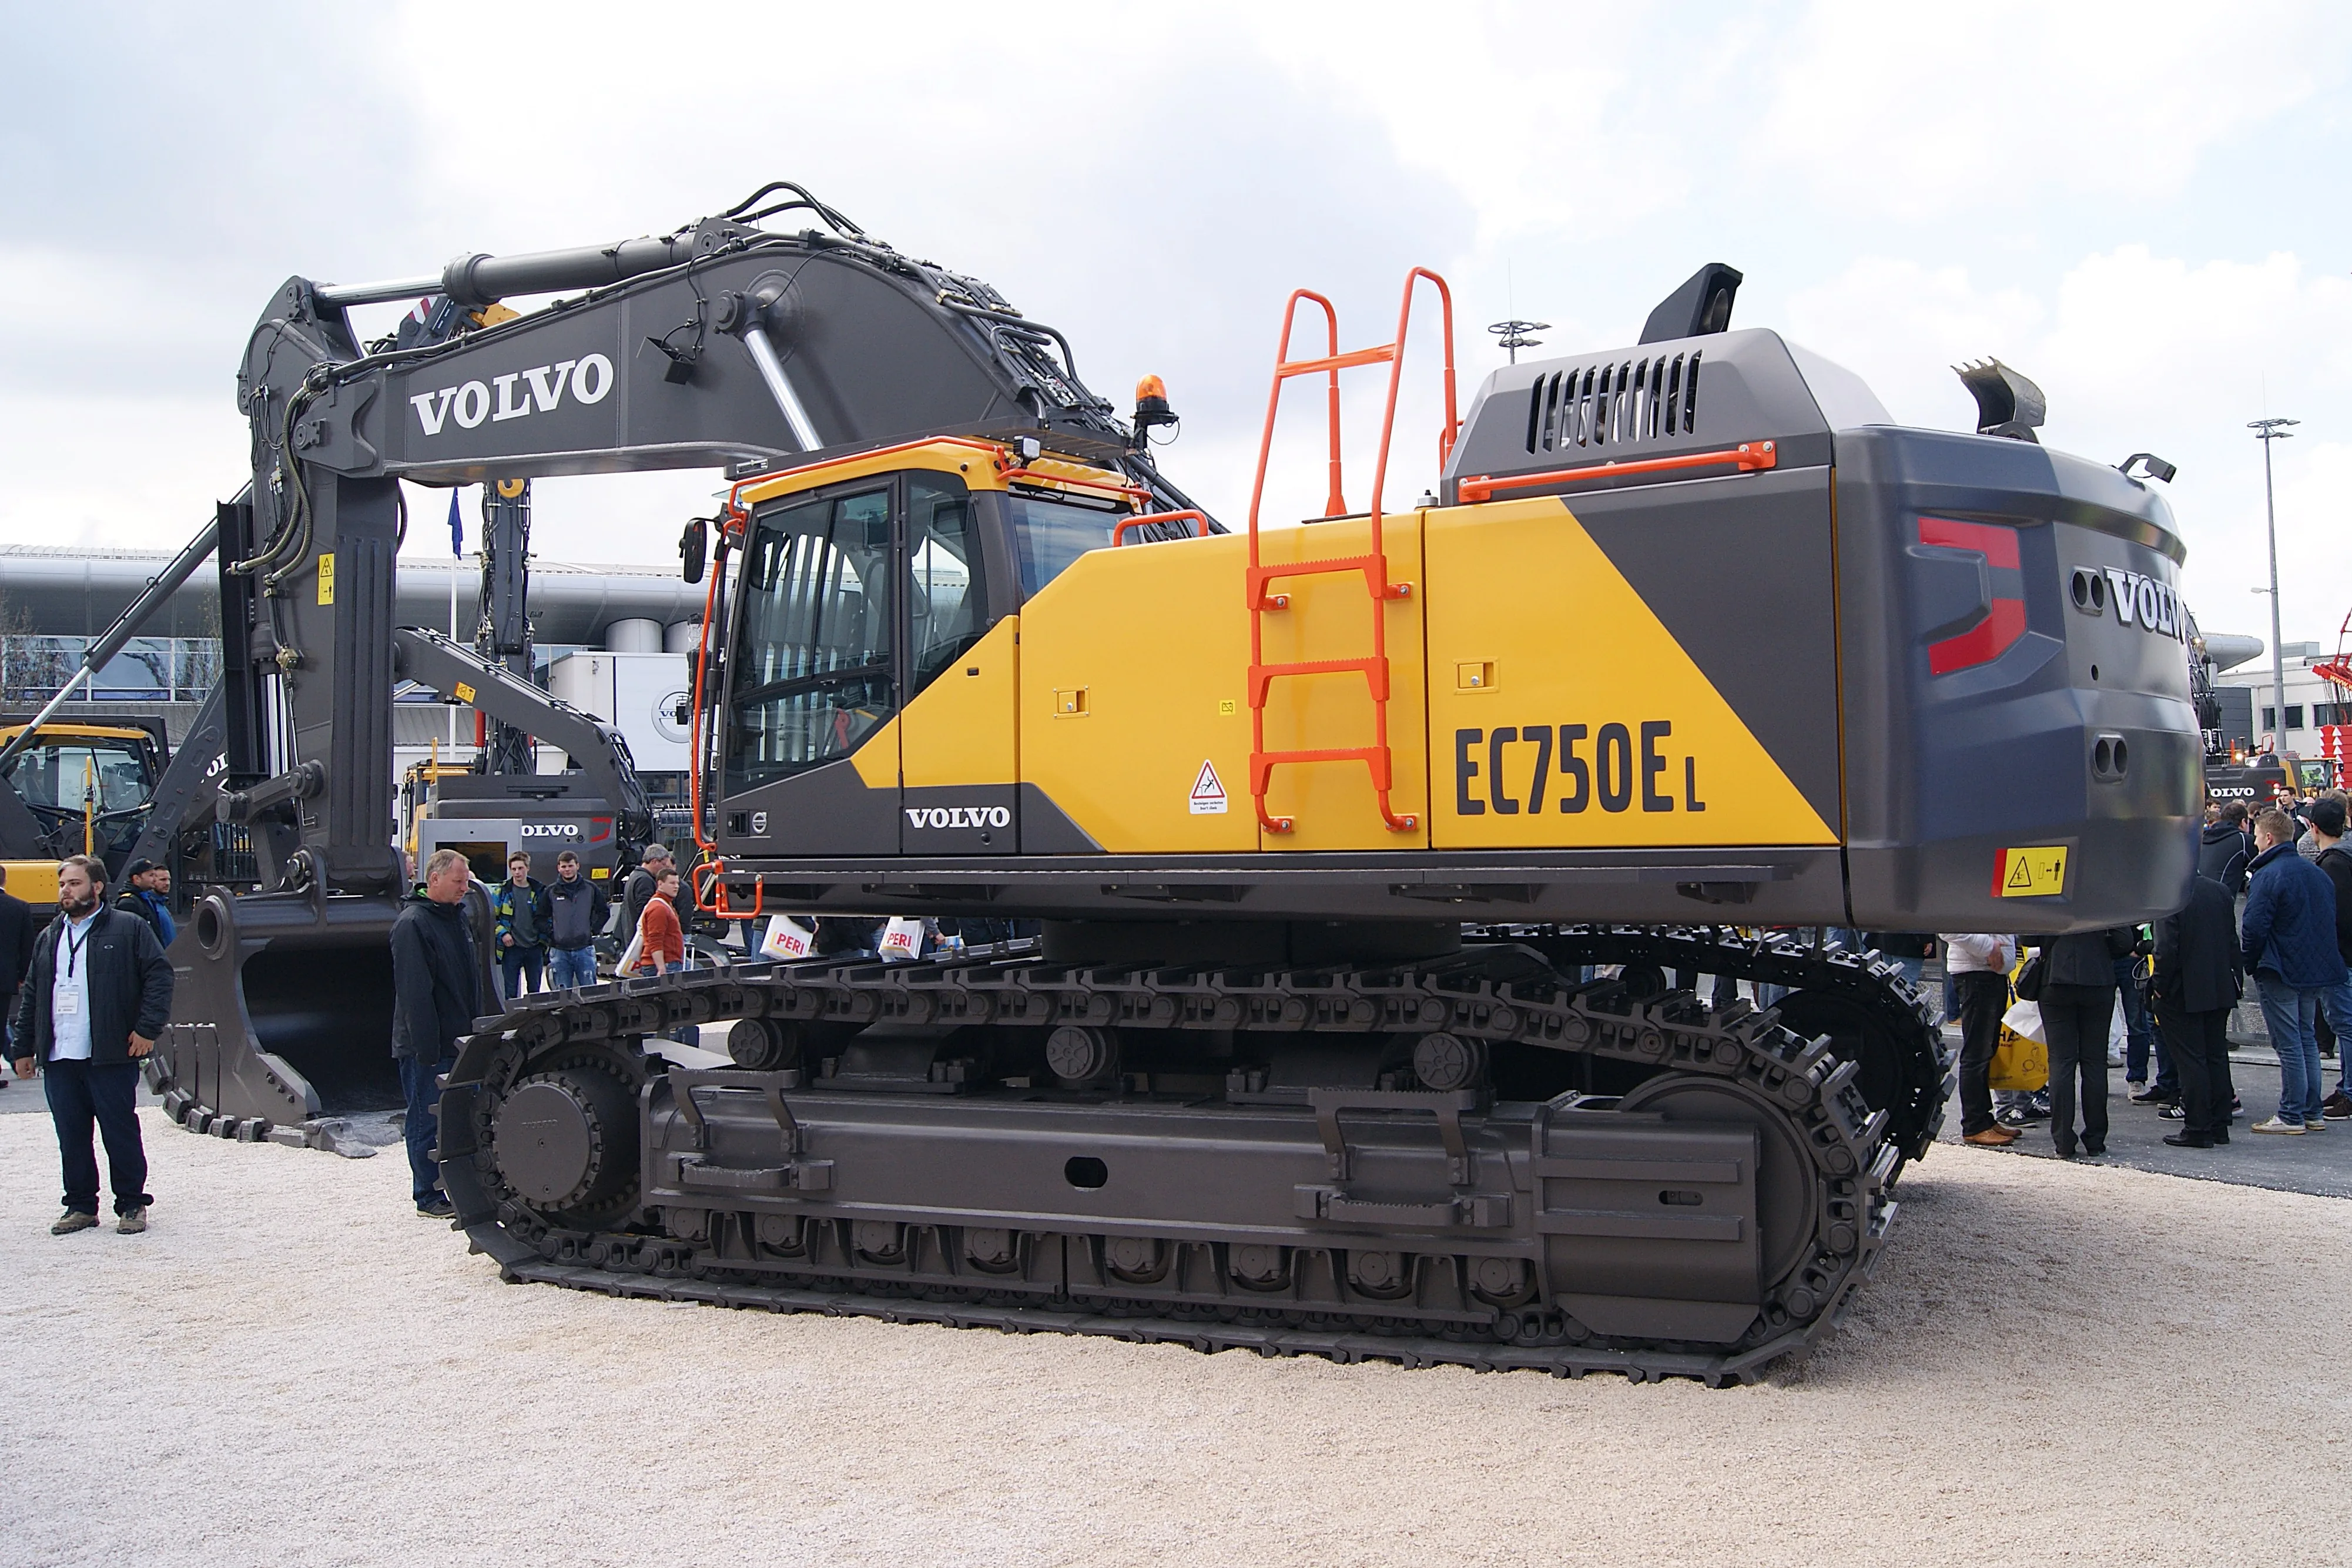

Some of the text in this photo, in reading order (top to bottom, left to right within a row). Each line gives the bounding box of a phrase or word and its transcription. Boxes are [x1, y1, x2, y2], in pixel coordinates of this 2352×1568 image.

[410, 353, 614, 435] VOLVO
[2210, 787, 2255, 798] OLVO
[906, 806, 1010, 828] VOLVO
[521, 824, 578, 837] OLVO
[776, 933, 805, 955] PERI
[887, 933, 912, 947] PERI
